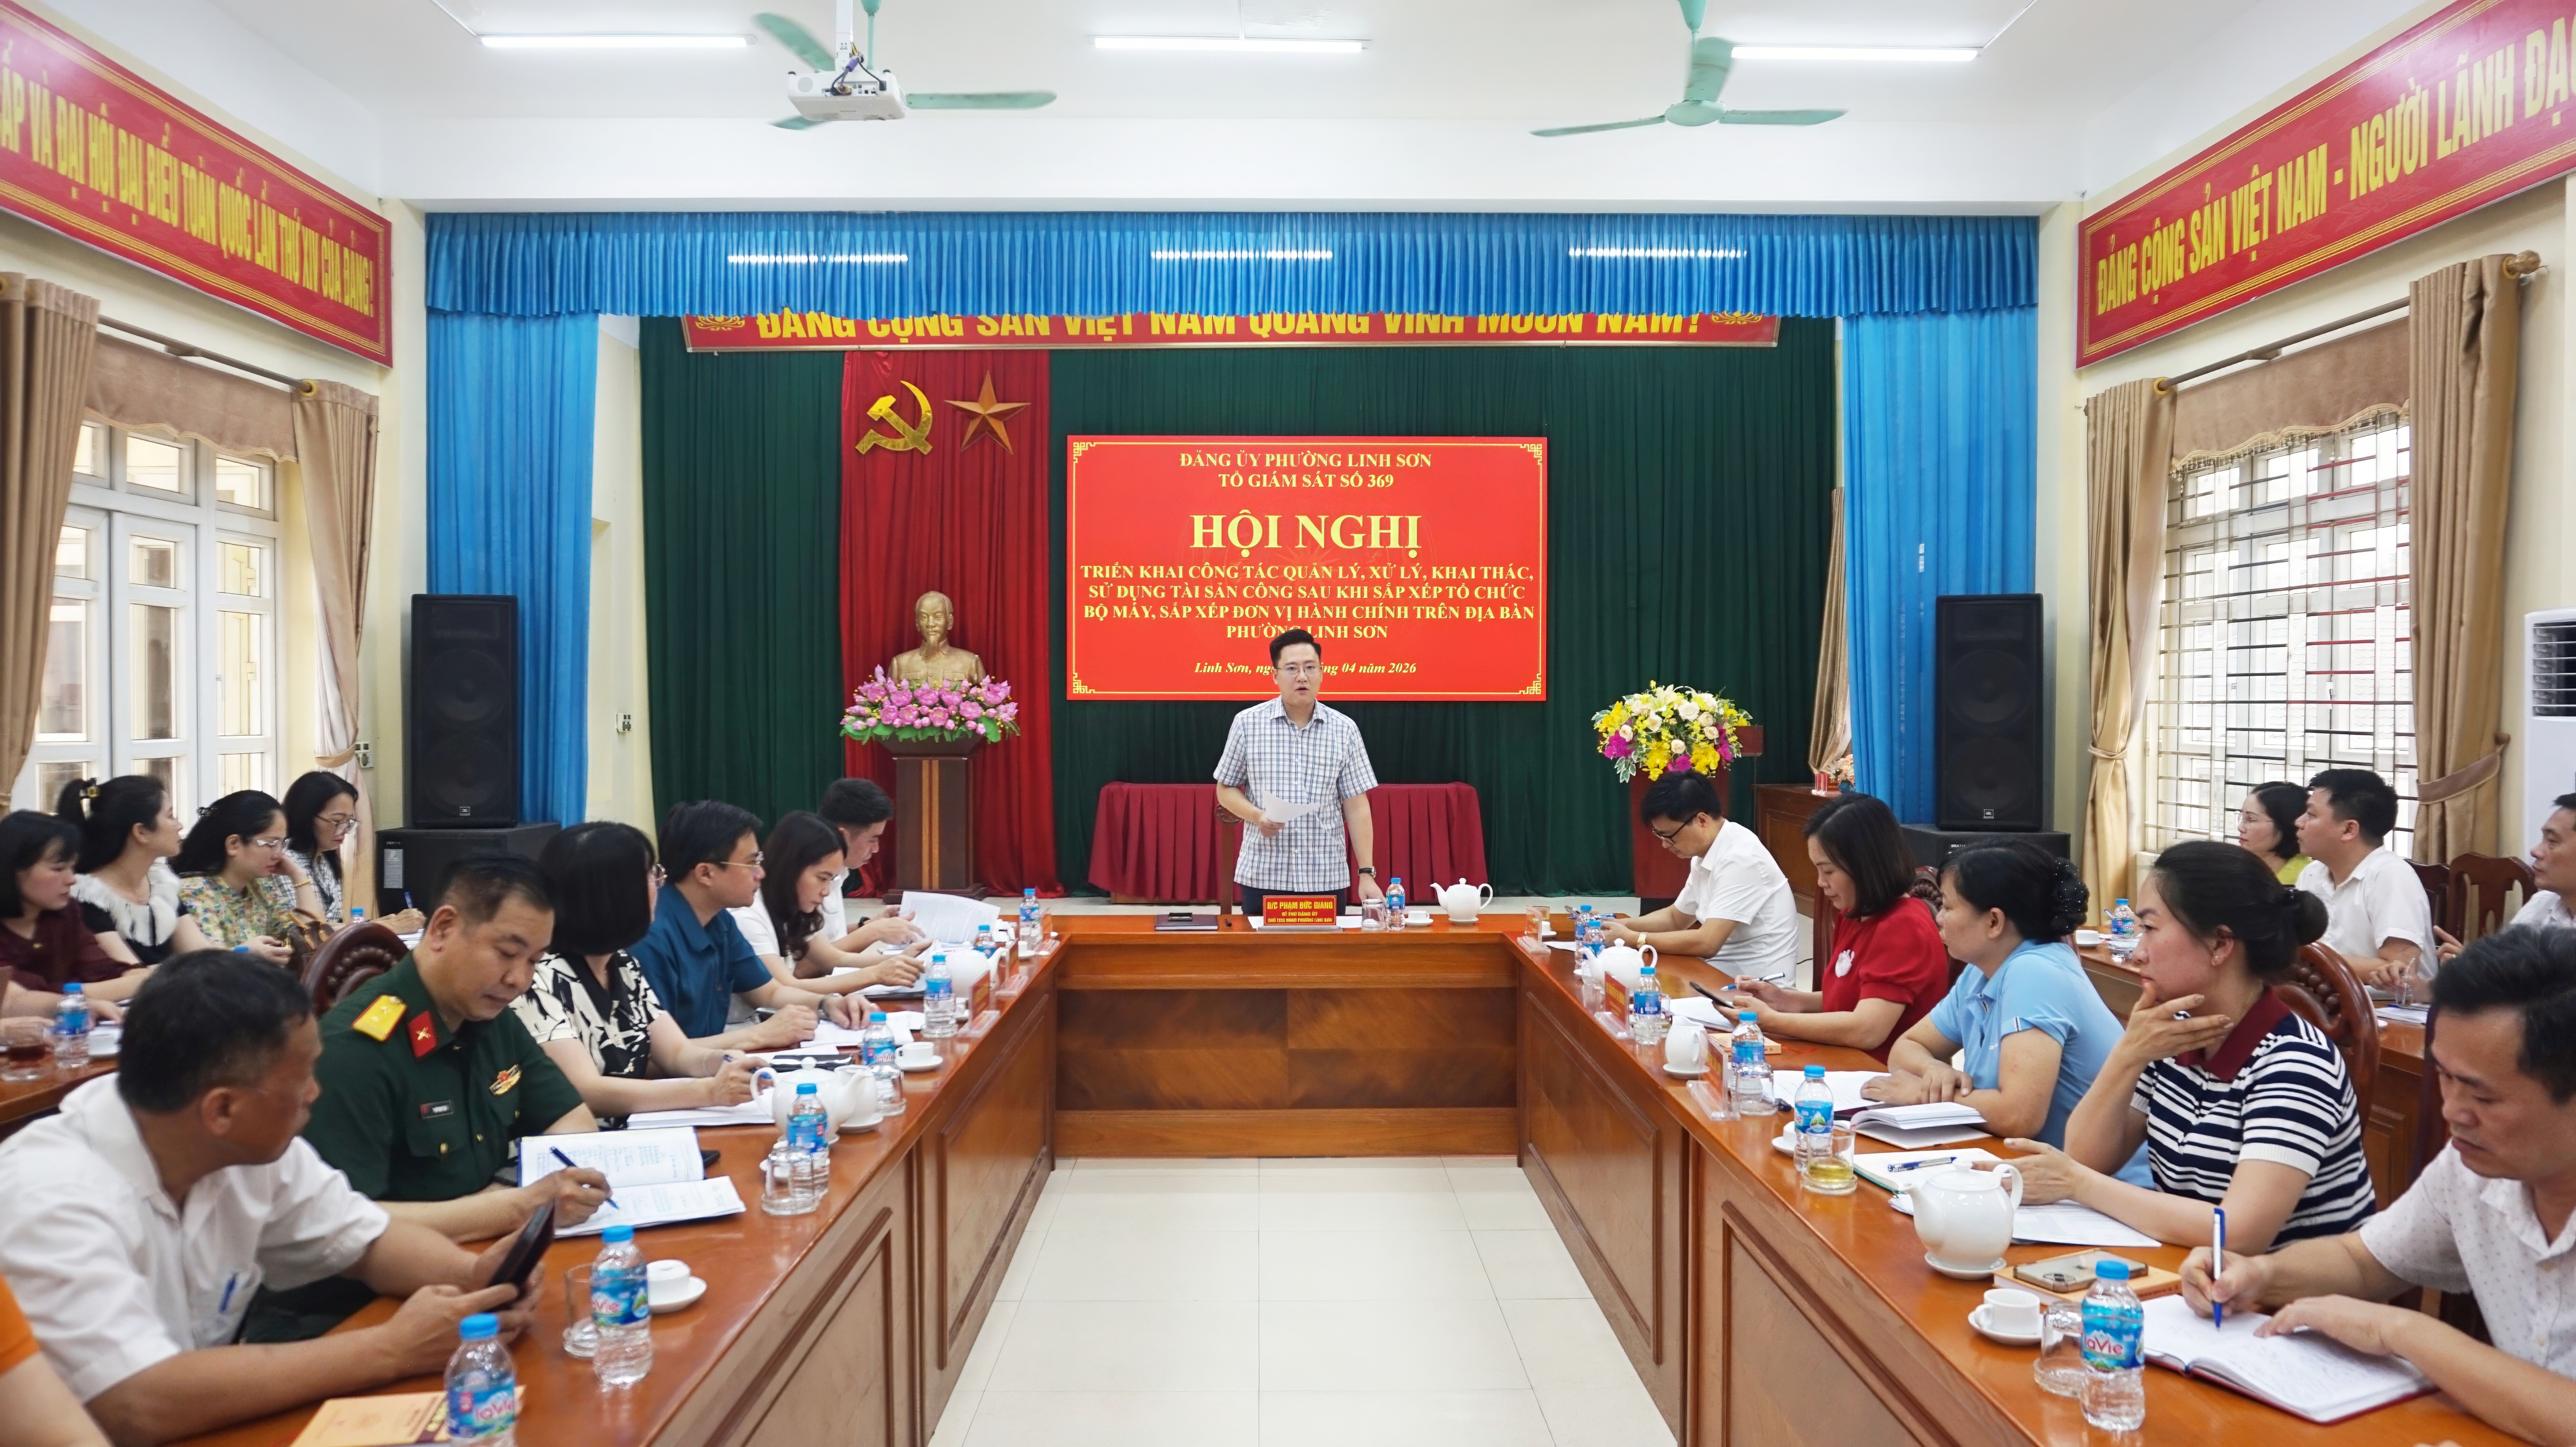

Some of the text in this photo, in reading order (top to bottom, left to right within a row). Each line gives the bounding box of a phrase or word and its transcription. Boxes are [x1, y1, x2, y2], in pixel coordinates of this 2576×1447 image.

[2097, 234, 2137, 315] ĐẢNG
[2140, 217, 2184, 303] CỘNG
[2189, 183, 2226, 275] SẢN
[2230, 164, 2273, 262] VIỆT
[2277, 143, 2328, 234] NAM
[2349, 77, 2430, 201] NGƯỜI
[2436, 43, 2516, 160] LÃNH
[2525, 17, 2576, 127] ĐẠ
[29, 69, 53, 170] VÀ
[56, 95, 85, 199] ĐẠI
[88, 102, 117, 213] HỘI
[118, 128, 143, 225] ĐẠI
[146, 122, 179, 228] BIỂU
[181, 154, 217, 247] TOÀN
[219, 167, 252, 260] QUỐC
[254, 179, 277, 274] LẦN
[279, 207, 301, 284] THỨ
[301, 225, 319, 293] XIV
[322, 218, 342, 303] CỦA
[343, 230, 374, 317] ĐẢNG!
[1179, 450, 1432, 467] ĐẢNG ỦY PHƯỜNG LINH SƠN
[1218, 470, 1394, 487] TỔ GIÁM SÁT SỐ 369
[1190, 510, 1422, 558] HỘI NGHỊ
[1080, 562, 1534, 581] TRIỂN KHAI CÔNG TÁC QUẢN LÝ, XỬ LÝ, KHAI THÁC,
[1089, 582, 1525, 601] SỬ DỤNG TÀI SẢN CÔNG SAU KHI SẮP XẾP TỔ CHỨC
[1084, 602, 1534, 622] BỘ MÁY, SẮP XẾP ĐƠN VỊ HÀNH CHÍNH TRÊN ĐỊA BÀN
[1307, 626, 1350, 638] LINH
[1354, 625, 1387, 638] SƠN
[1195, 662, 1222, 673] Linh
[1226, 663, 1252, 674] Sơn,
[1342, 663, 1355, 673] 04
[1358, 663, 1386, 673] năm
[1388, 663, 1416, 673] 2026
[1280, 902, 1297, 911] PHẠM
[1299, 901, 1312, 910] ĐỨC
[1314, 902, 1333, 910] GIANG
